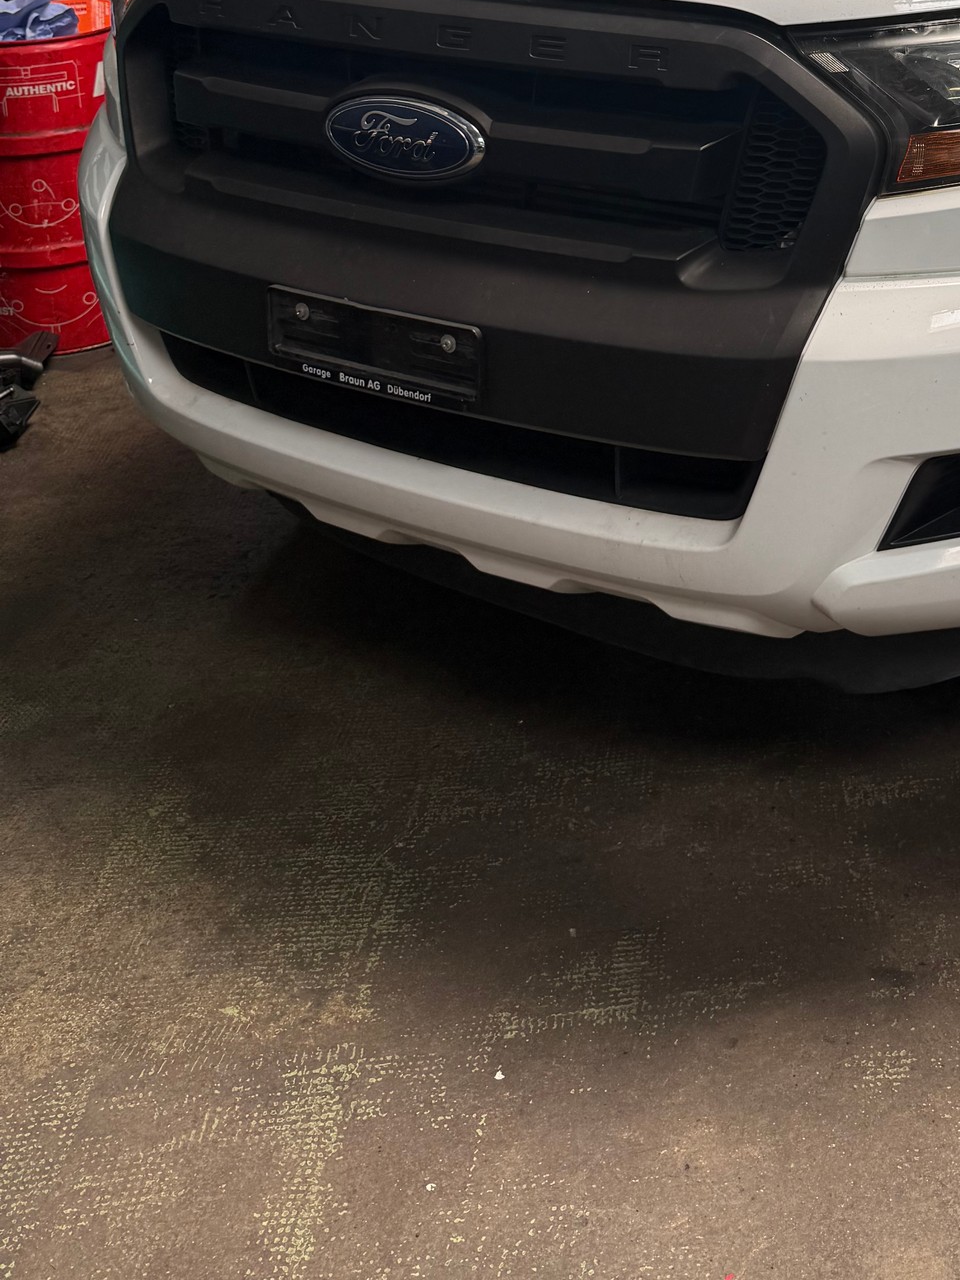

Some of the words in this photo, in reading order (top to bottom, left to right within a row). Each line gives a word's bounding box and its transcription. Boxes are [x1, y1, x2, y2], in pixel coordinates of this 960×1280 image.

[6, 80, 76, 96] AUTHENTIC
[353, 110, 438, 162] Ford
[302, 363, 332, 379] Garage
[339, 372, 366, 387] Braun
[367, 380, 381, 391] AG
[387, 384, 432, 402] Dübendorf
